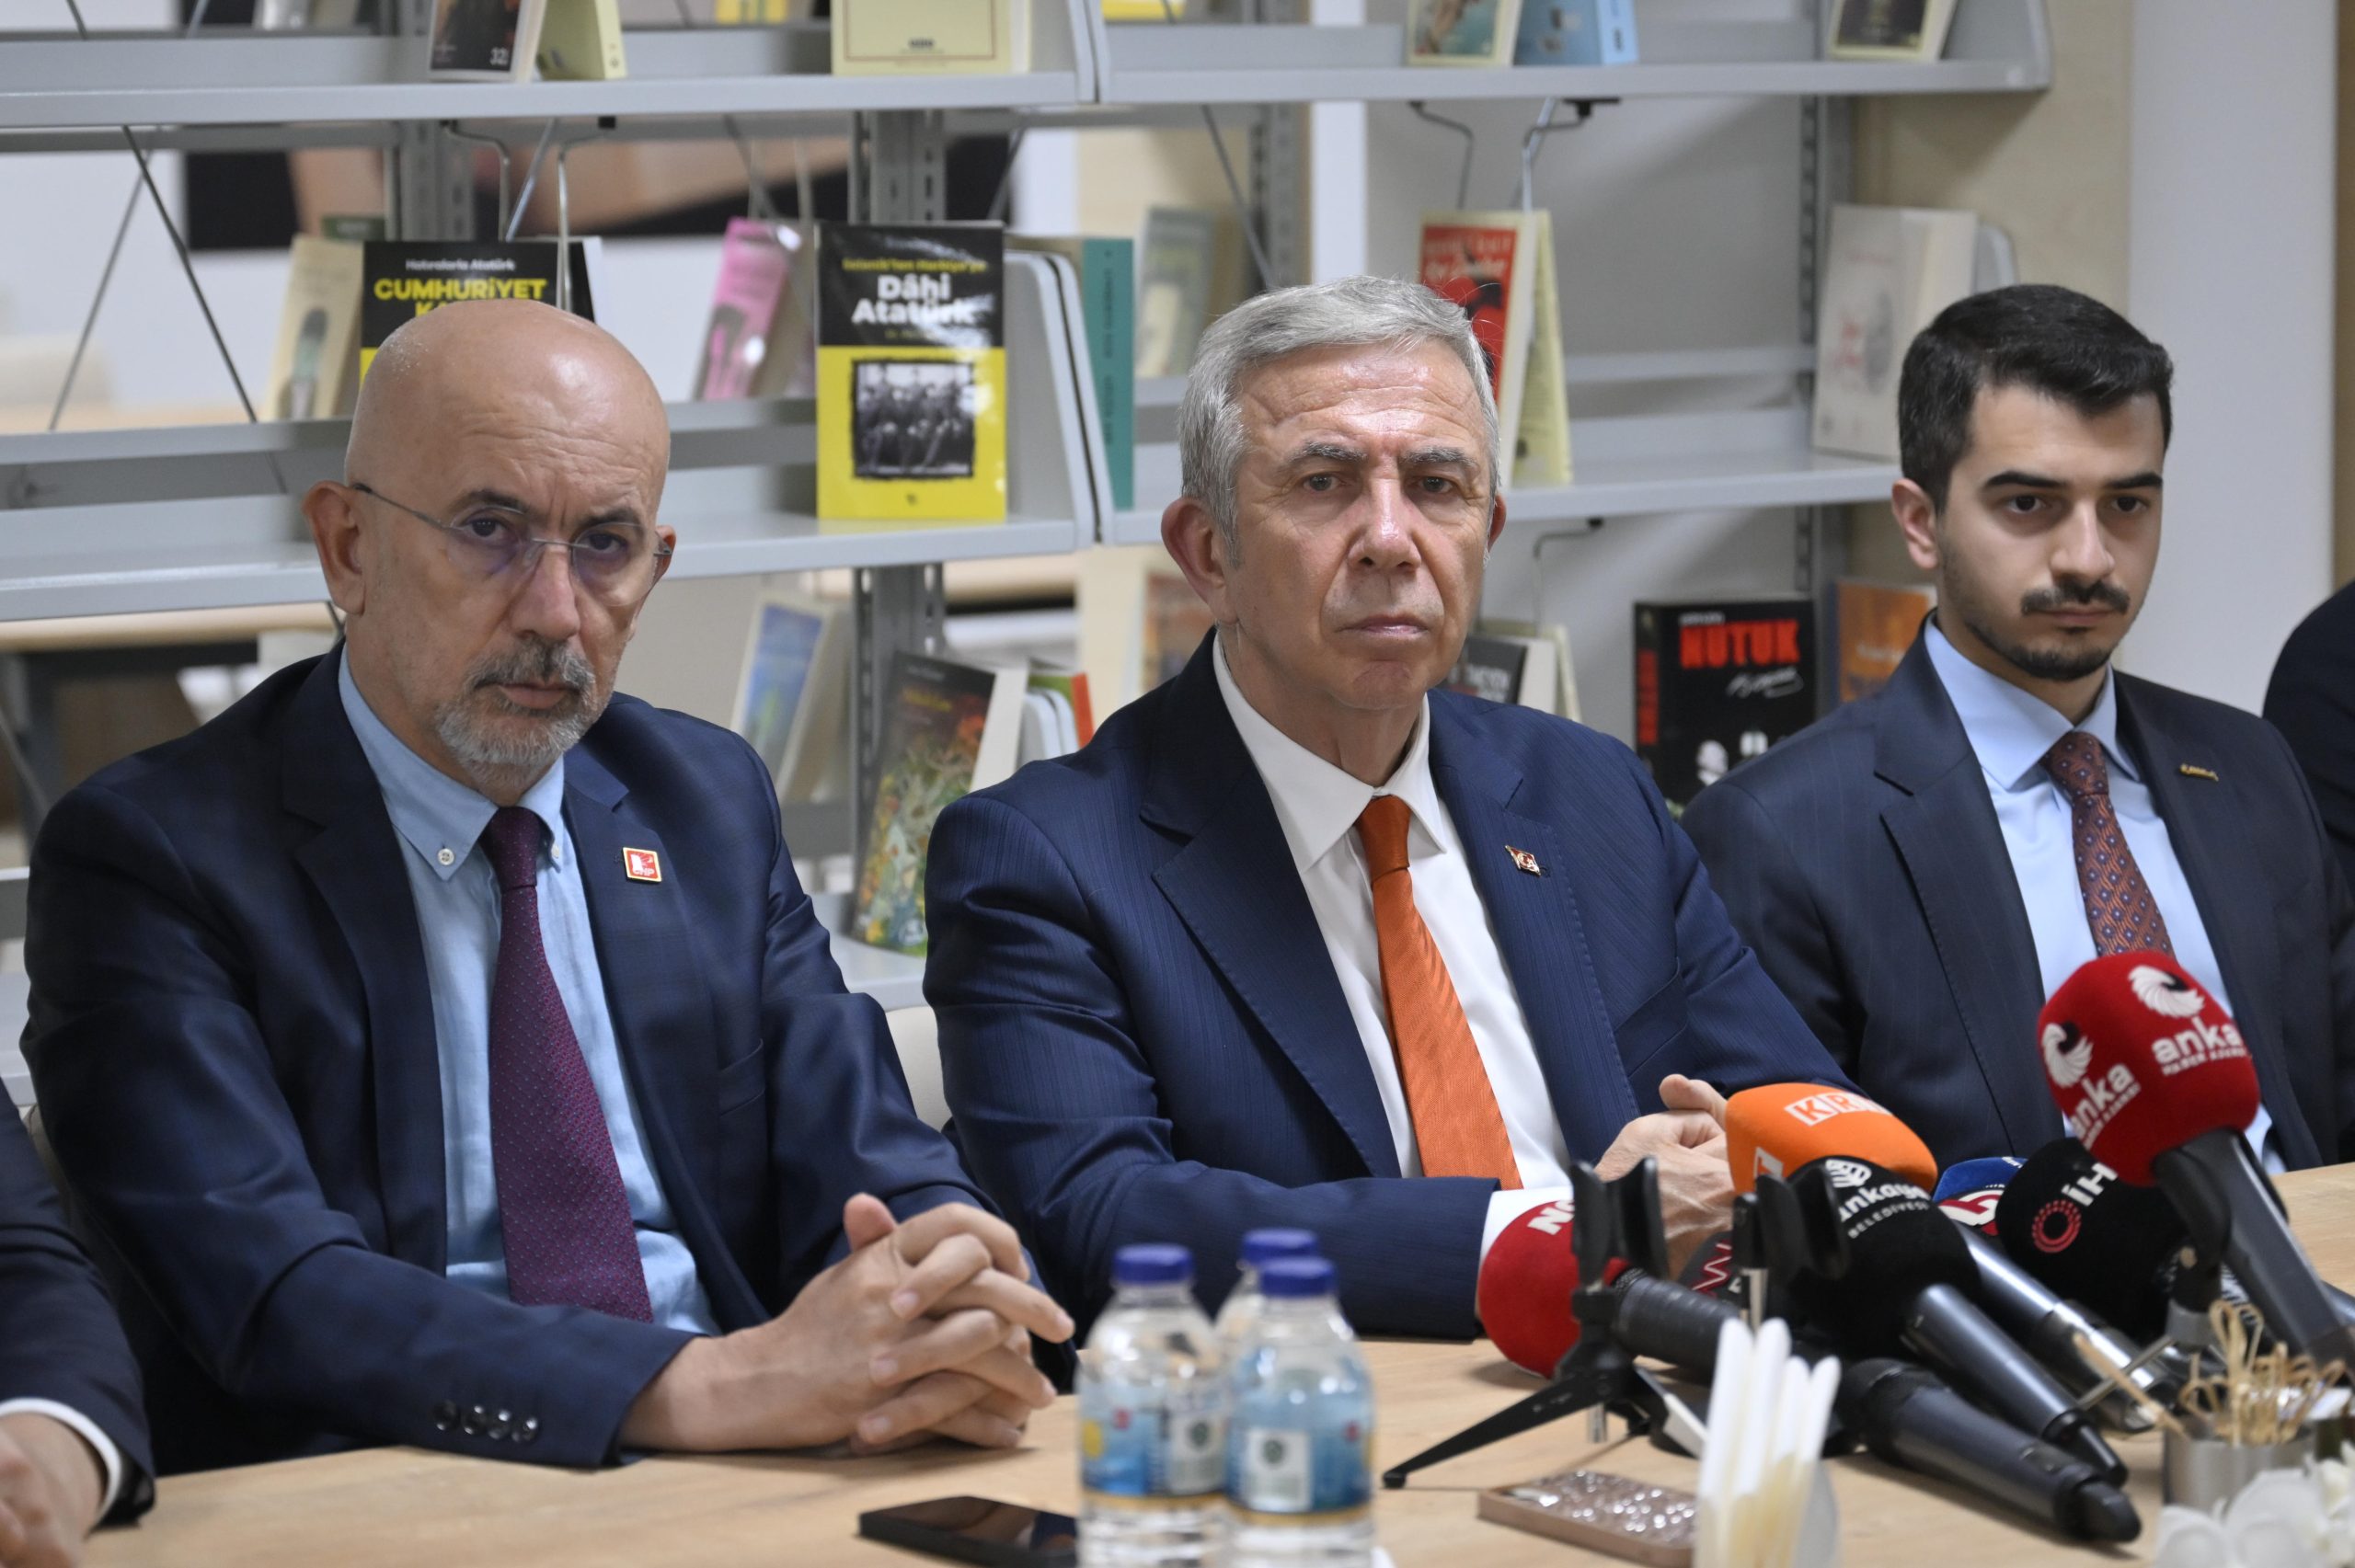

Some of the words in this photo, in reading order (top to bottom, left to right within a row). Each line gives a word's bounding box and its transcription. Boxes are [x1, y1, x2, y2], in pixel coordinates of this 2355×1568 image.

[470, 258, 515, 270] Atatürk
[851, 297, 977, 325] Atatürk
[1680, 619, 1799, 670] NUTUK
[2152, 1015, 2242, 1065] anka
